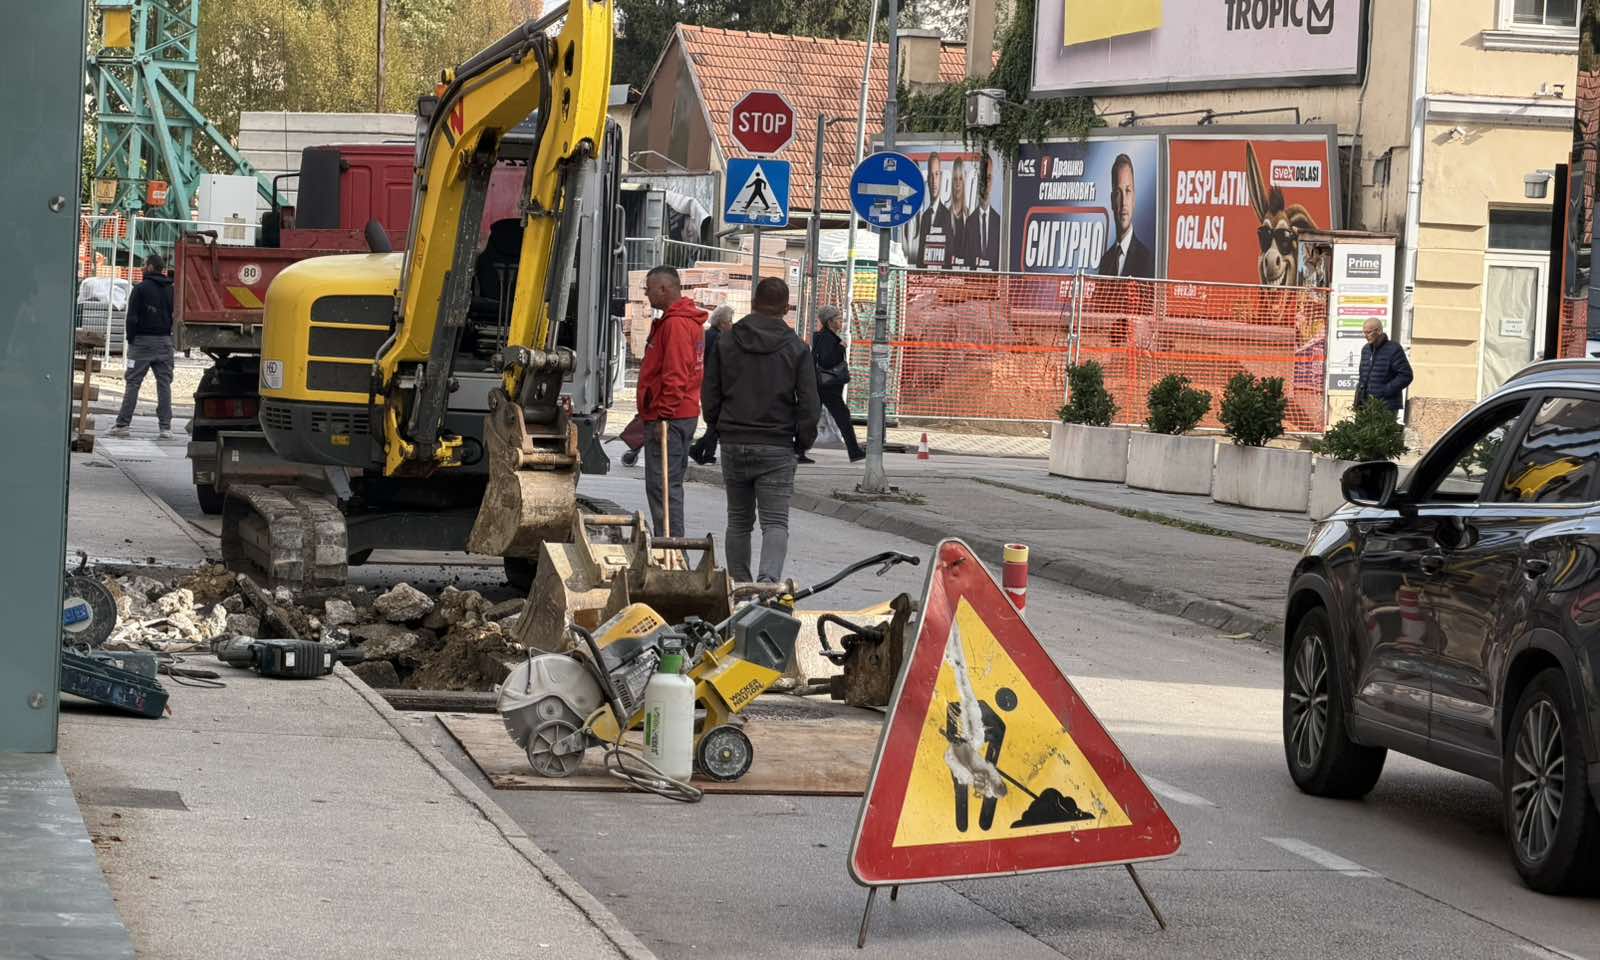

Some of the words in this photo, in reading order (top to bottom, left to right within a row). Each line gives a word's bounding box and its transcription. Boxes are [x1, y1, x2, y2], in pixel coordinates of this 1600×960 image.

[1224, 0, 1304, 31] TROPIC
[739, 112, 786, 134] STOP
[1051, 157, 1084, 179] Драшко
[1296, 166, 1319, 182] OGLASI
[1039, 181, 1096, 201] СТАНИВУКОВИЋ
[1175, 215, 1227, 251] OGLASI.
[1025, 220, 1104, 269] СИГУРНО
[243, 268, 256, 278] 80
[1348, 257, 1380, 268] Prime
[1337, 379, 1352, 387] 065
[729, 677, 759, 701] WACKER
